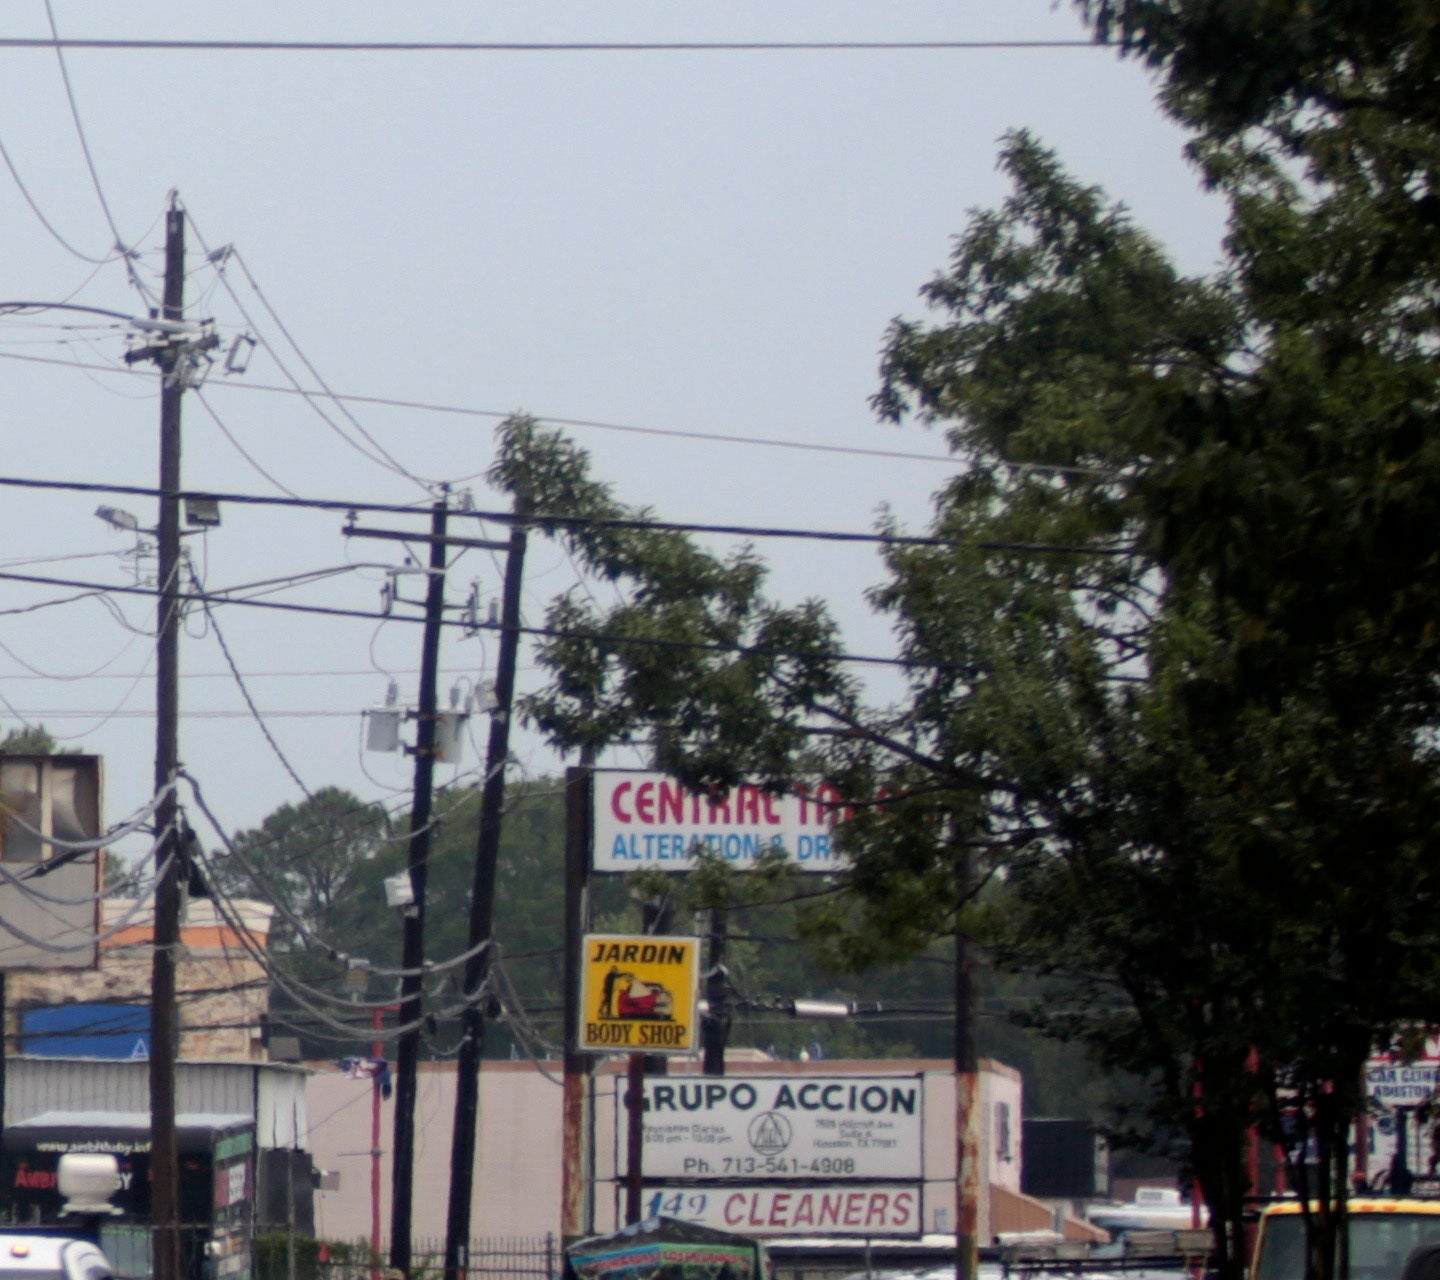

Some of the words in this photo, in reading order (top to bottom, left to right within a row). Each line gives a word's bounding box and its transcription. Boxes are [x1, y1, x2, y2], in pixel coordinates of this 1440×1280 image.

[592, 943, 687, 965] JARDIN
[587, 1022, 633, 1044] BODY
[638, 1023, 687, 1044] SHOP
[774, 1083, 917, 1114] ACCION
[683, 1157, 716, 1174] Ph.
[724, 1192, 914, 1228] CLEANERS
